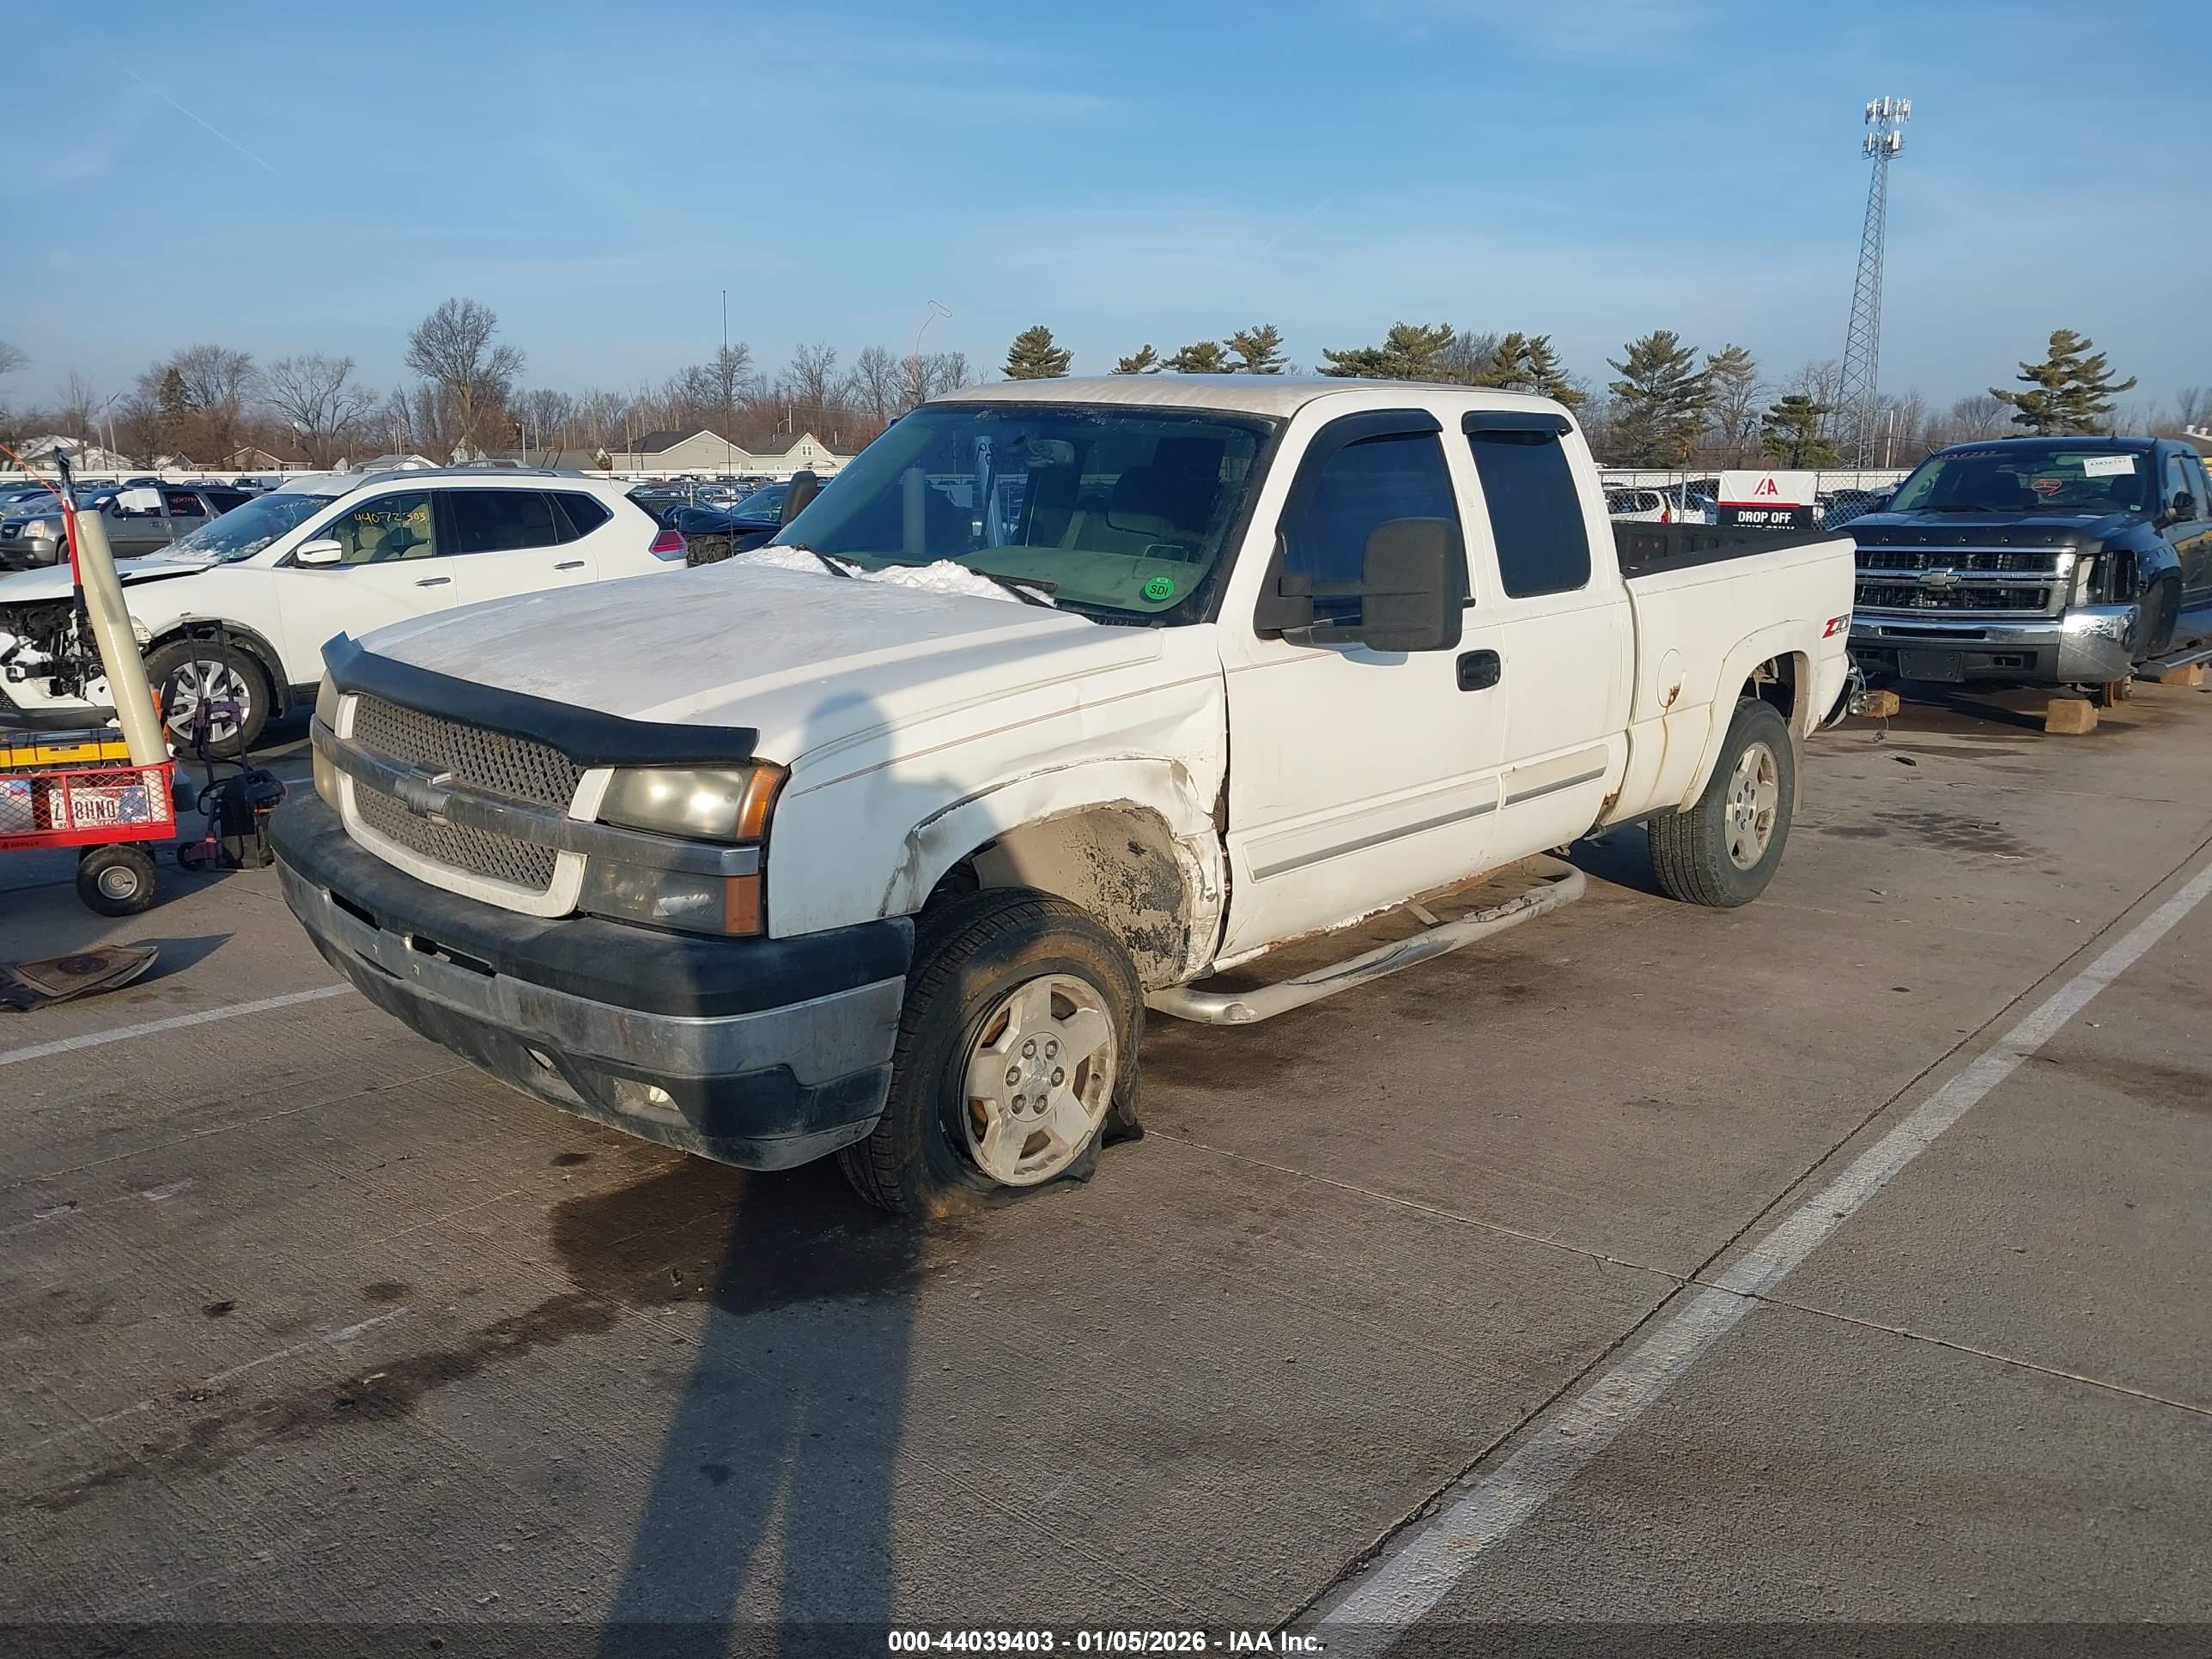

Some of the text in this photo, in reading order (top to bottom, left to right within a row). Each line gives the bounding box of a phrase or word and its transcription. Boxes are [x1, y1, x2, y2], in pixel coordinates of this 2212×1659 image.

[1737, 511, 1792, 524] DROP OFF
[1149, 584, 1170, 597] SDI
[1821, 613, 1850, 639] Z71
